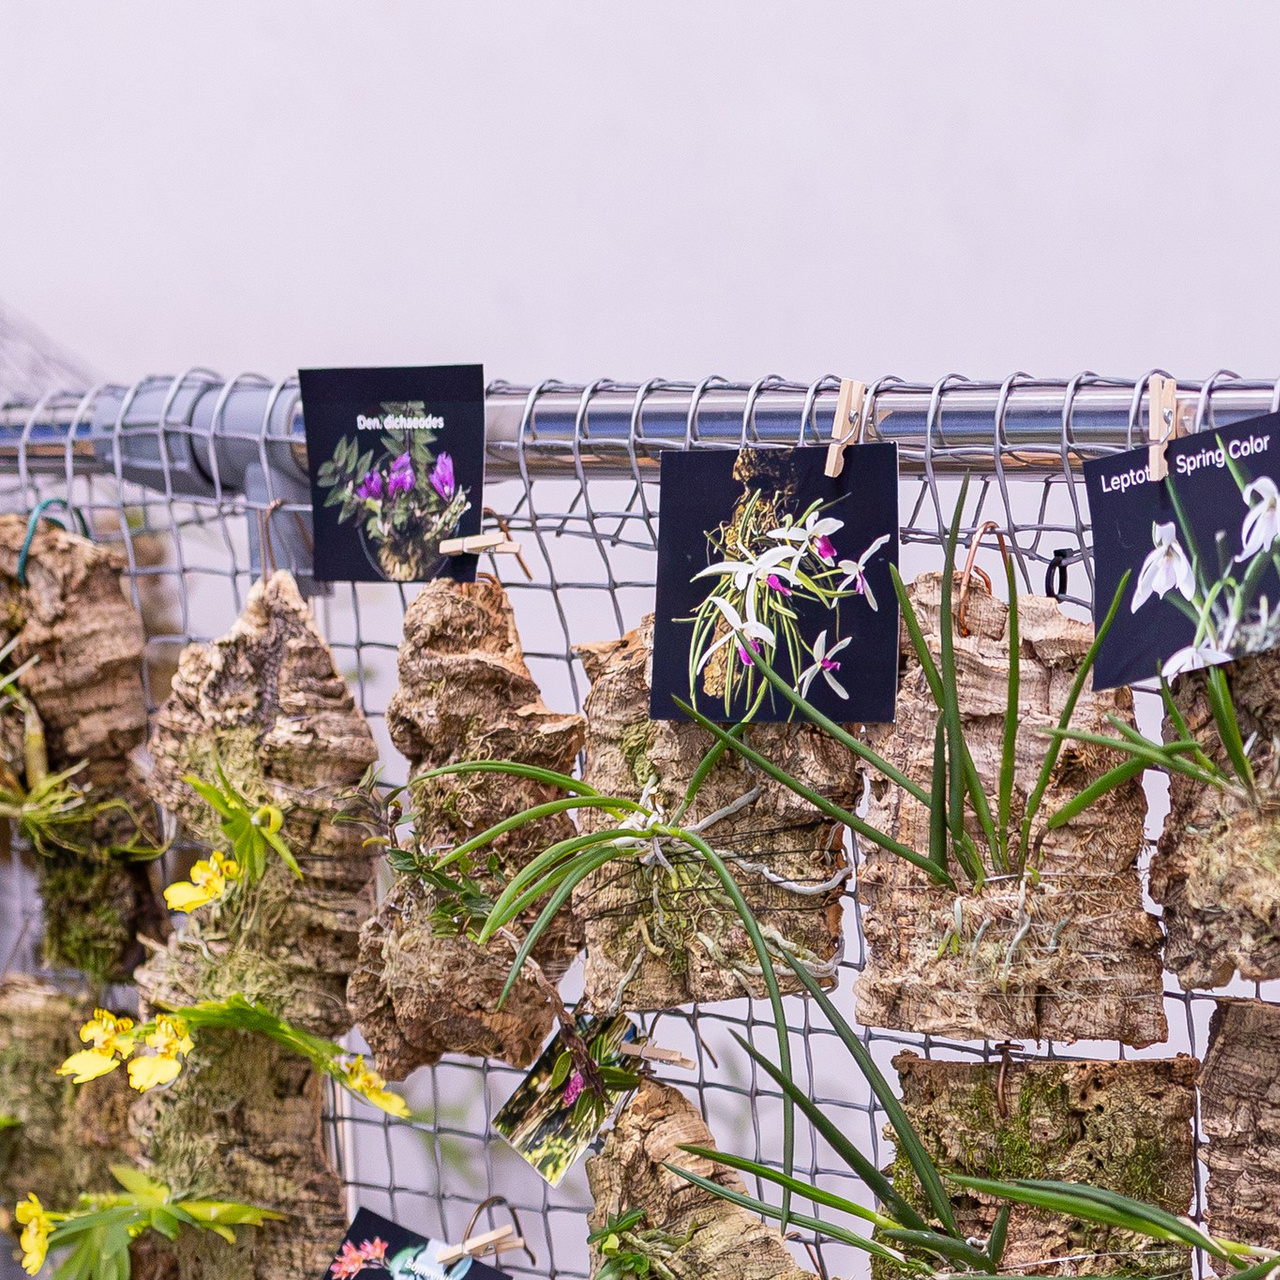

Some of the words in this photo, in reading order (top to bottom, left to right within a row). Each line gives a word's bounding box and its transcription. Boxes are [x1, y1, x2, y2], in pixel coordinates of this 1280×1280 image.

[1101, 464, 1151, 493] Leptot
[1176, 449, 1226, 476] Spring
[1229, 435, 1271, 459] Color
